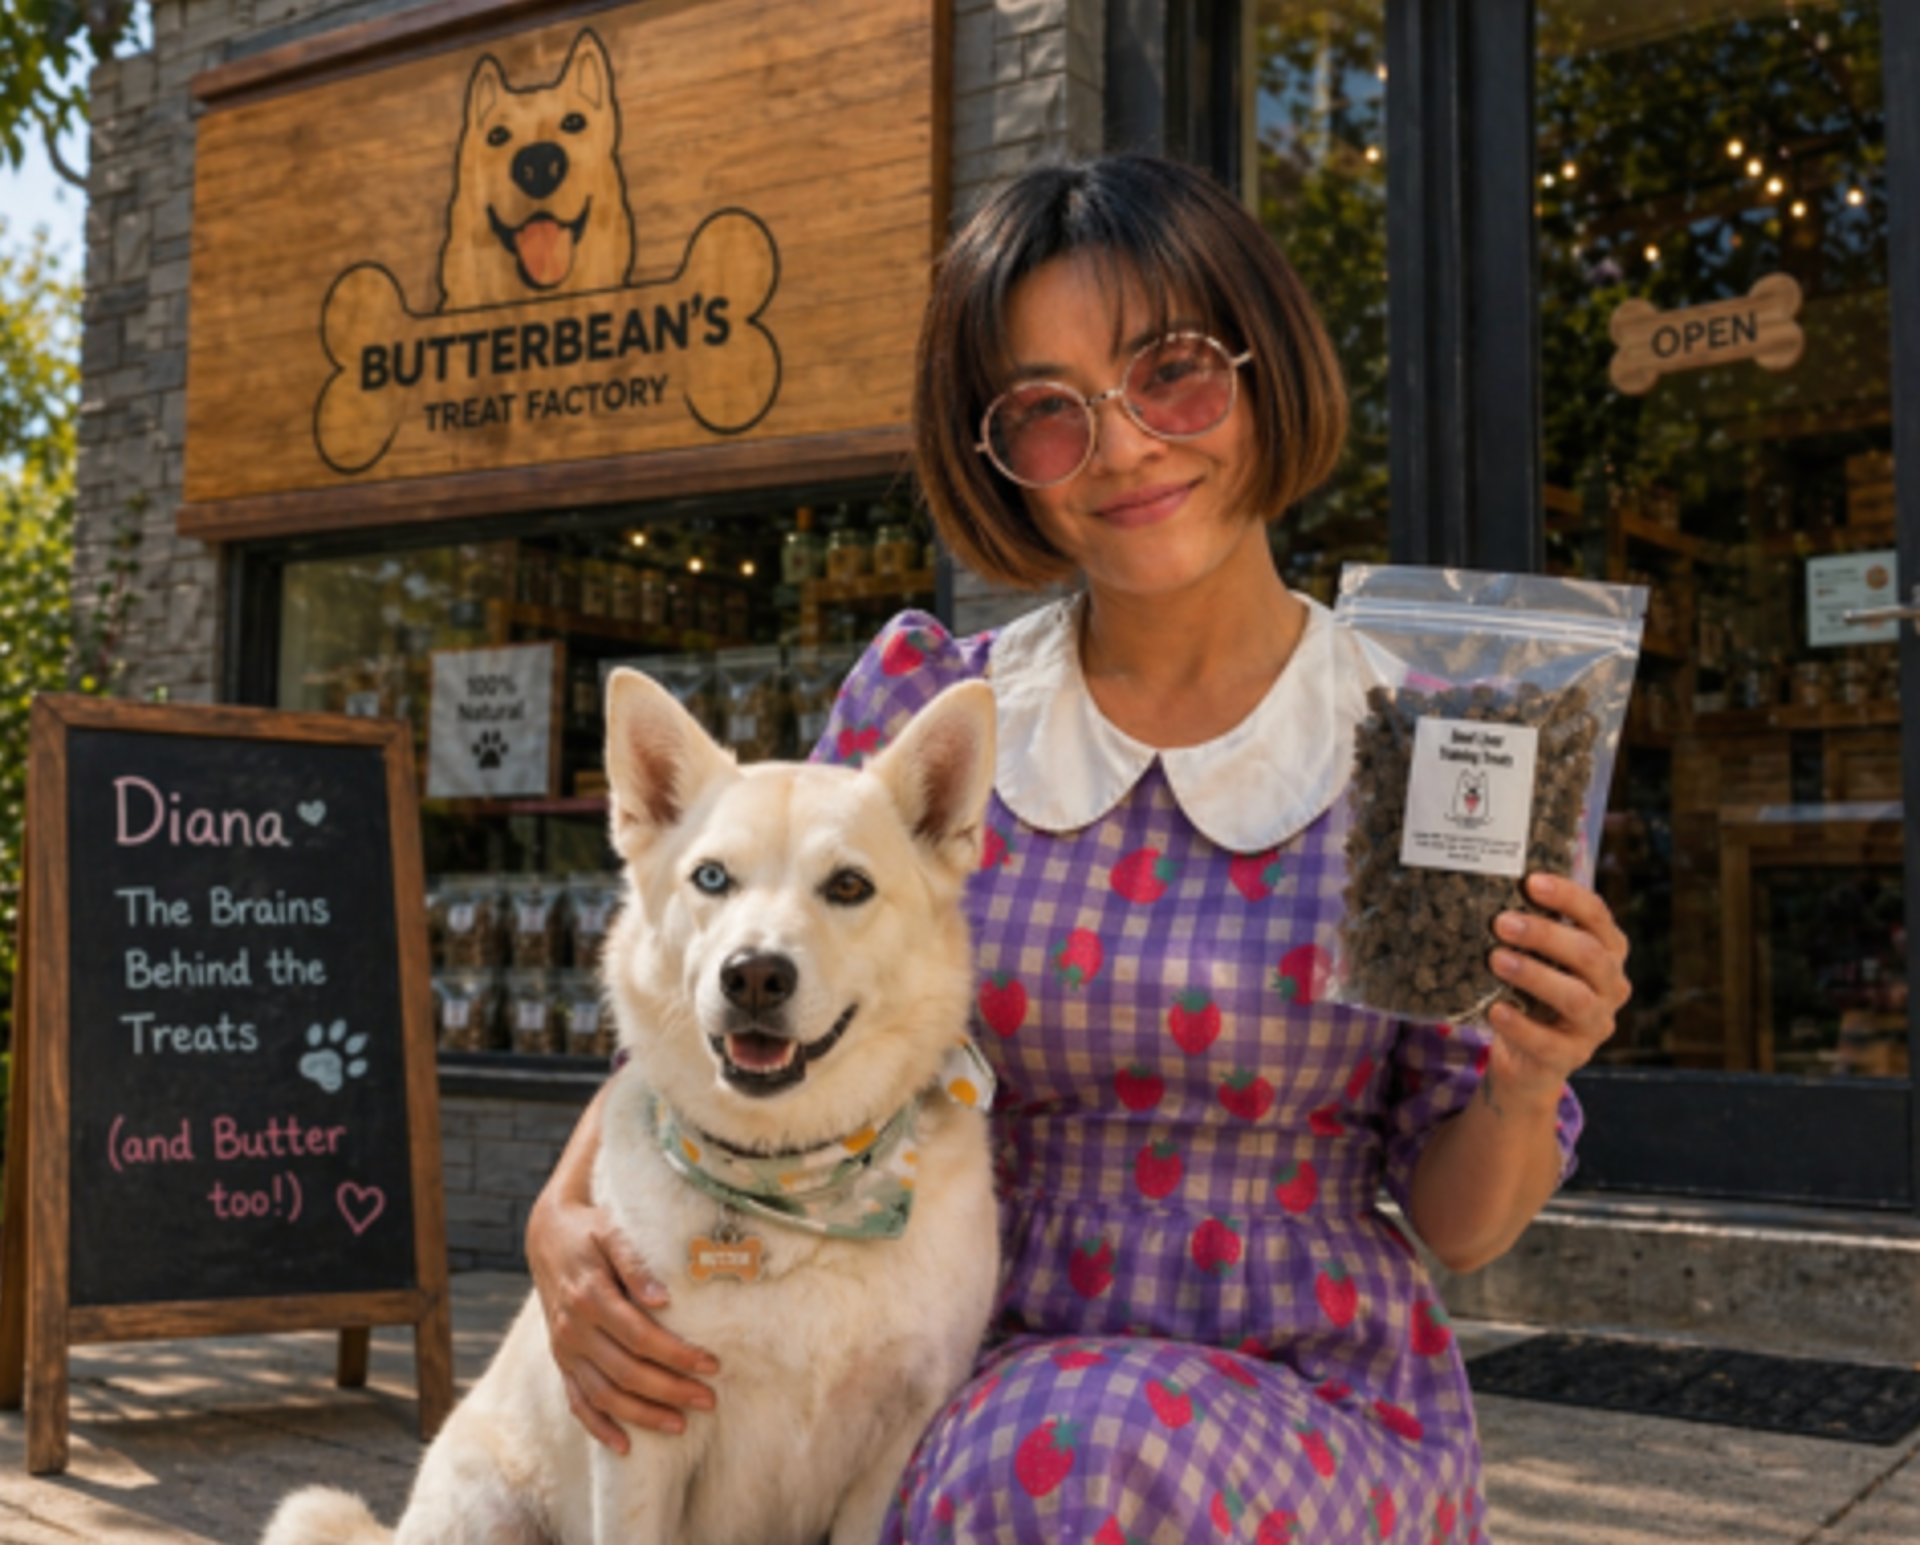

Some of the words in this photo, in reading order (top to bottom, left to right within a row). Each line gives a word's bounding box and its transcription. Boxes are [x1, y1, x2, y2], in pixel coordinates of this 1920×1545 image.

[360, 293, 731, 391] BUTTERBEAN'S
[1651, 309, 1758, 360] OPEN
[424, 393, 515, 432] TREAT
[526, 374, 669, 421] FACTORY
[456, 700, 526, 722] Natural
[467, 674, 518, 697] 100%
[113, 775, 292, 847] Diana
[115, 886, 192, 927] The
[209, 886, 331, 926] Brains
[125, 948, 252, 989] Behind
[265, 949, 328, 986] the
[119, 1012, 260, 1055] Treats
[107, 1114, 195, 1172] (and
[212, 1114, 347, 1161] Butter
[206, 1171, 303, 1223] too!)
